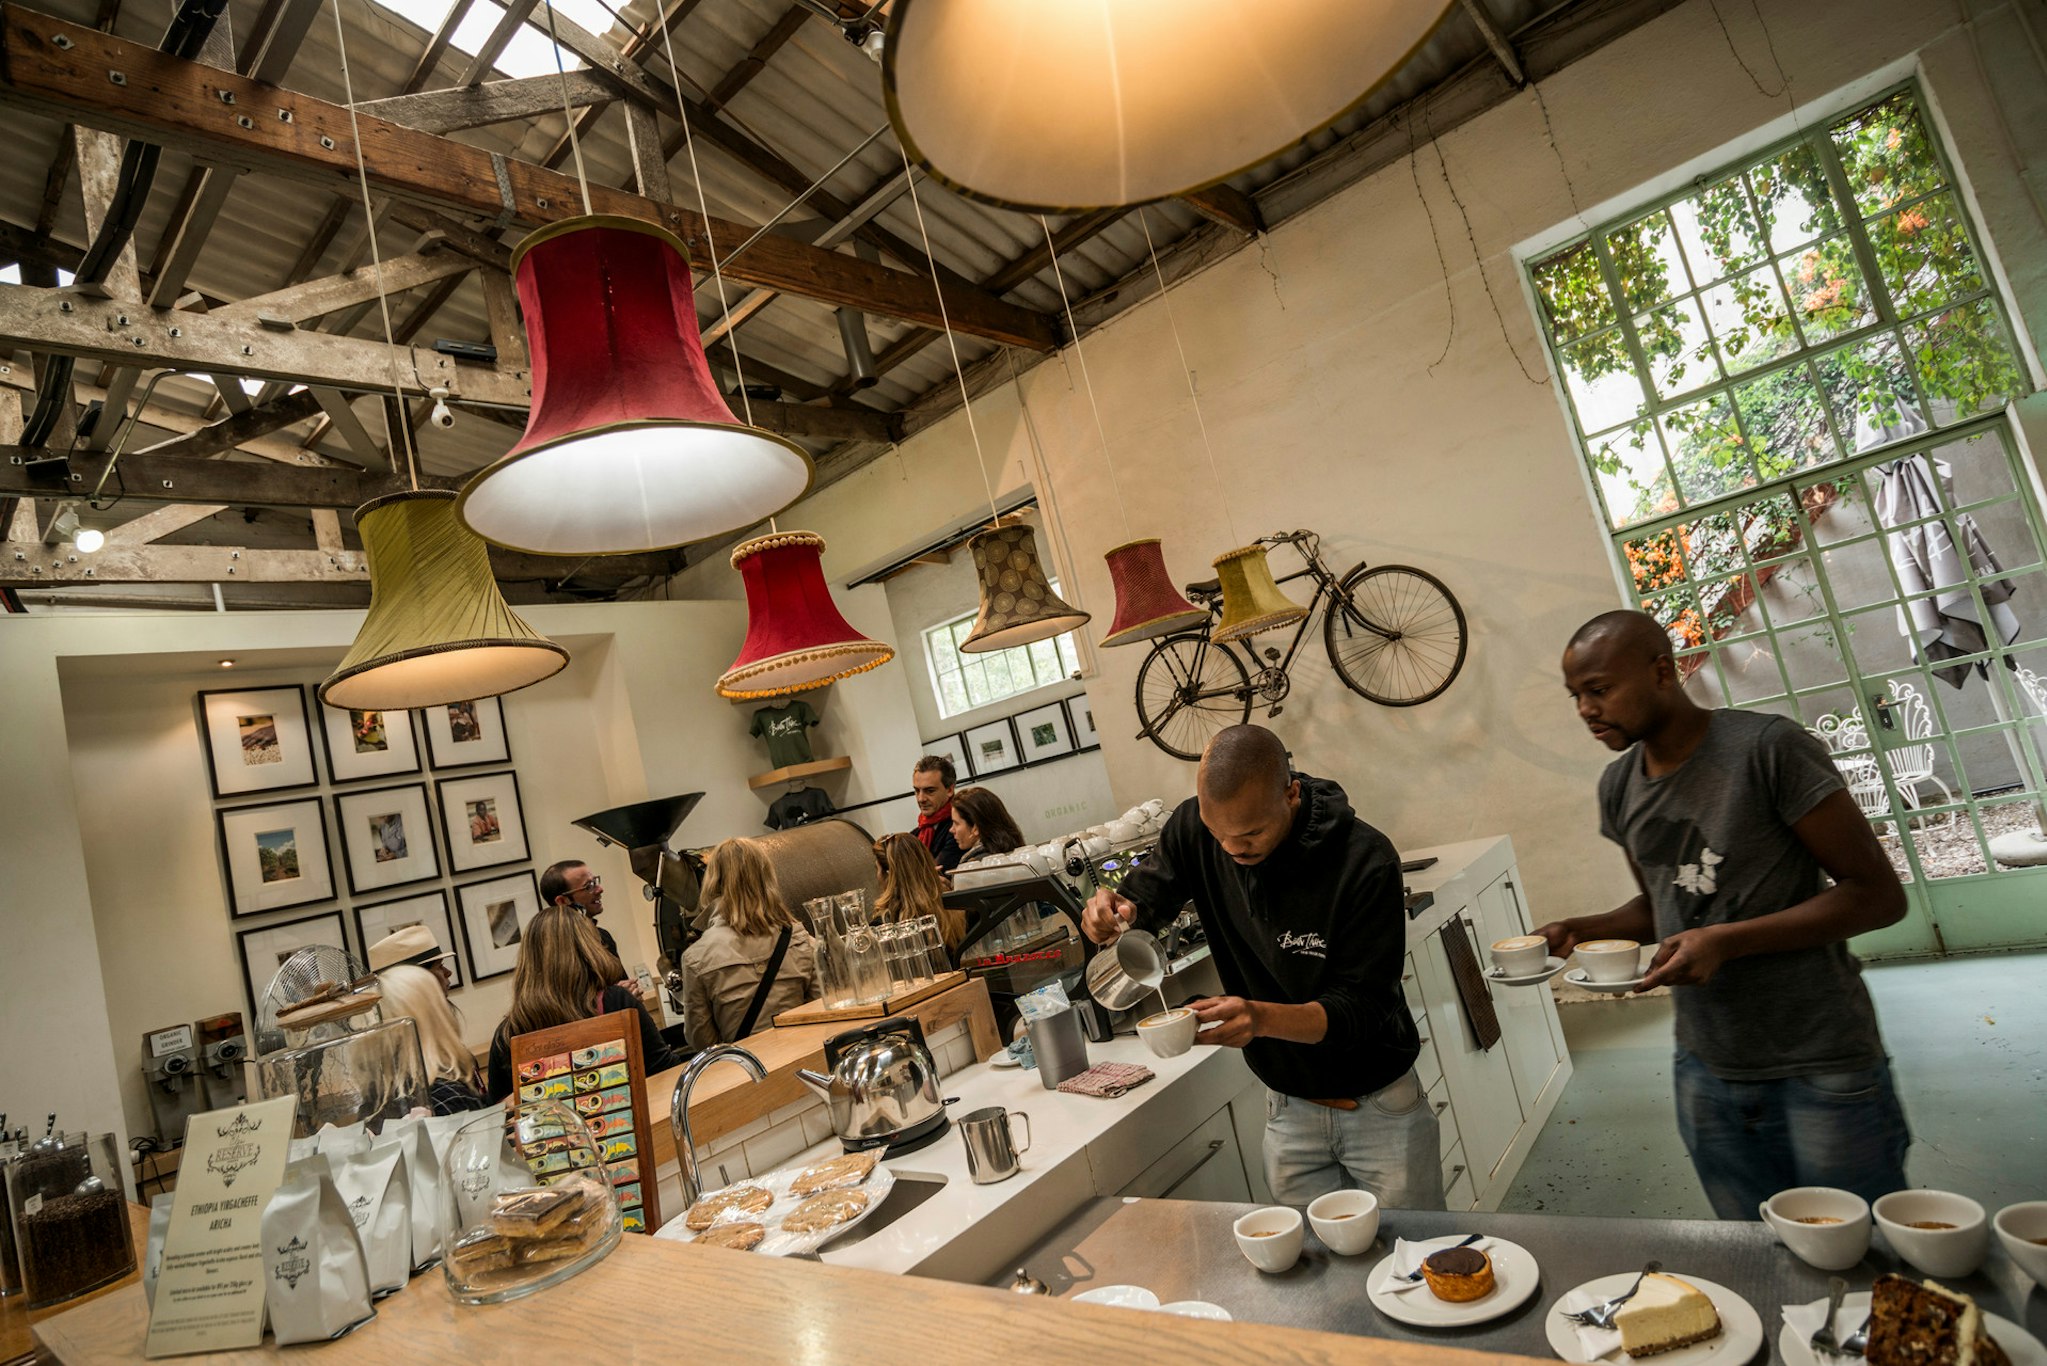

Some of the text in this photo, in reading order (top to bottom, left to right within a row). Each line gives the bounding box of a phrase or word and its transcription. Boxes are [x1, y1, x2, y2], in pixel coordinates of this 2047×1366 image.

[190, 1195, 259, 1217] ETHIOPIA YIRGACHEFFE
[209, 1218, 232, 1231] ARICHA
